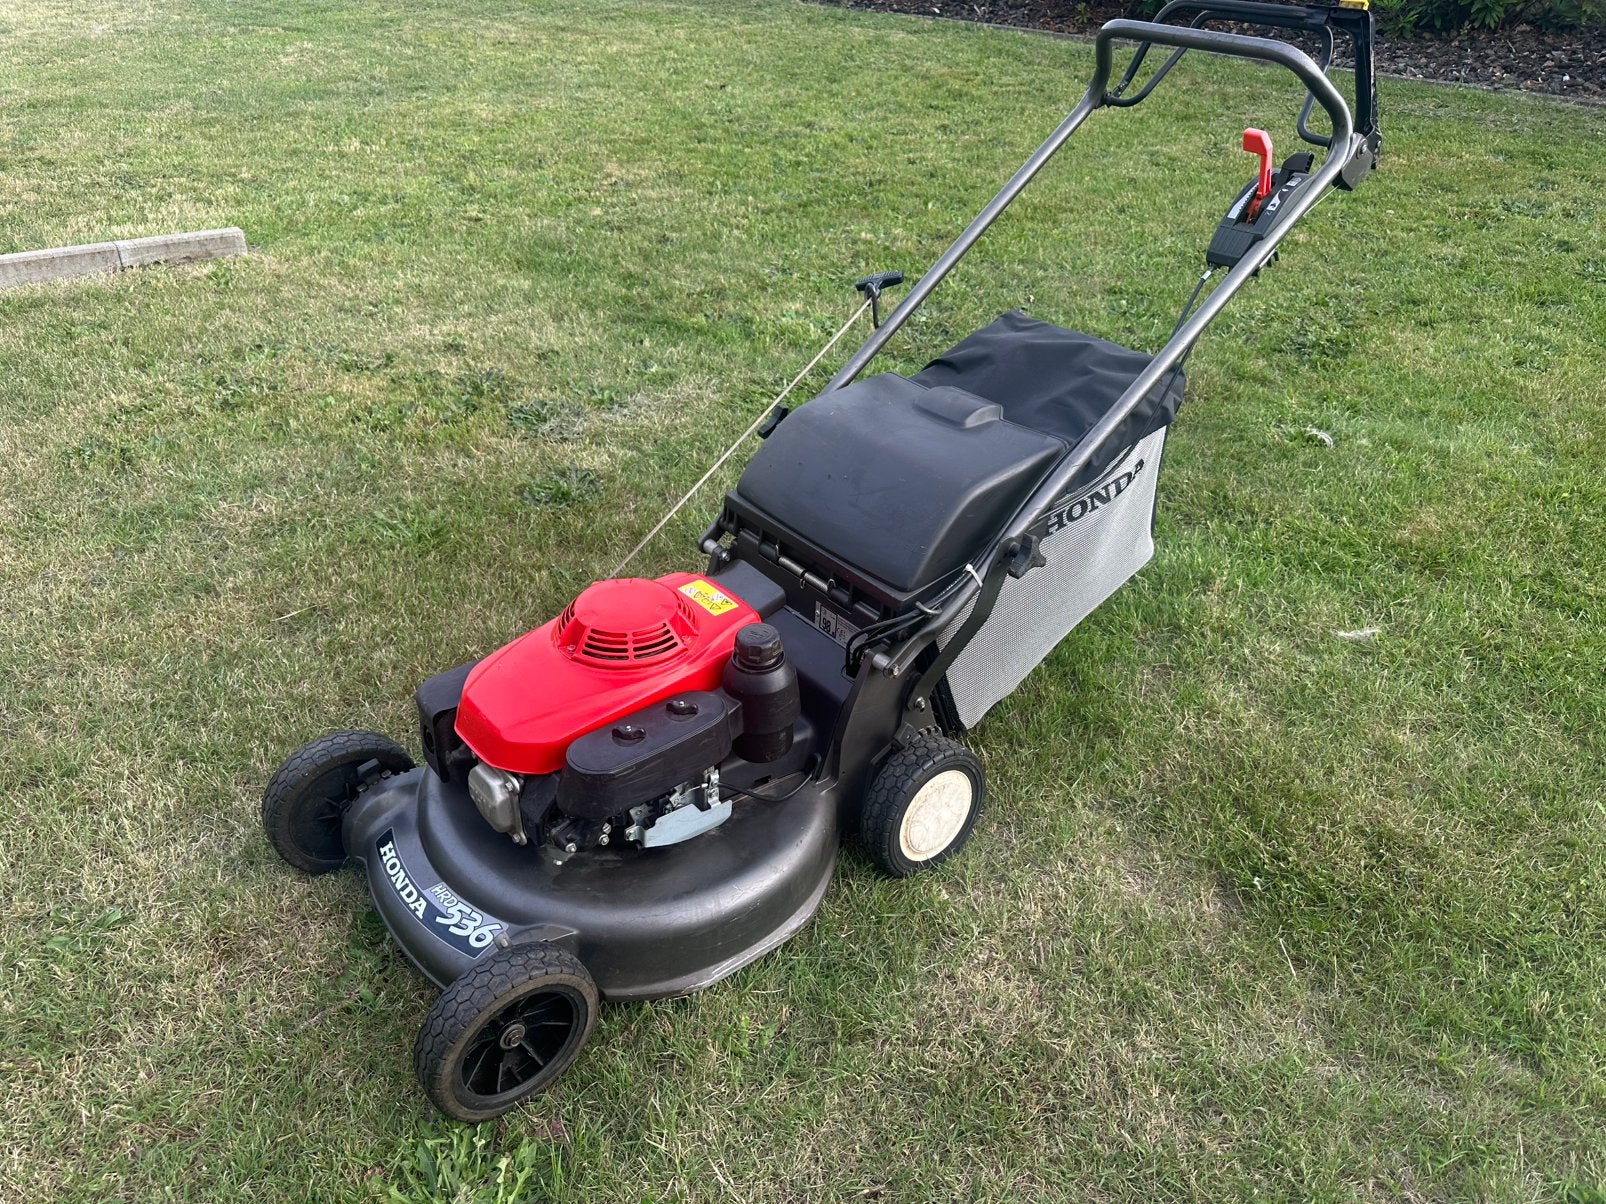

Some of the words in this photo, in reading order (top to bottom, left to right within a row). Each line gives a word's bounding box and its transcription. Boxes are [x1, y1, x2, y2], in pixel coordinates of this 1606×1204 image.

[380, 841, 428, 919] HONDA
[431, 884, 457, 908] HRD
[435, 901, 501, 948] 536
